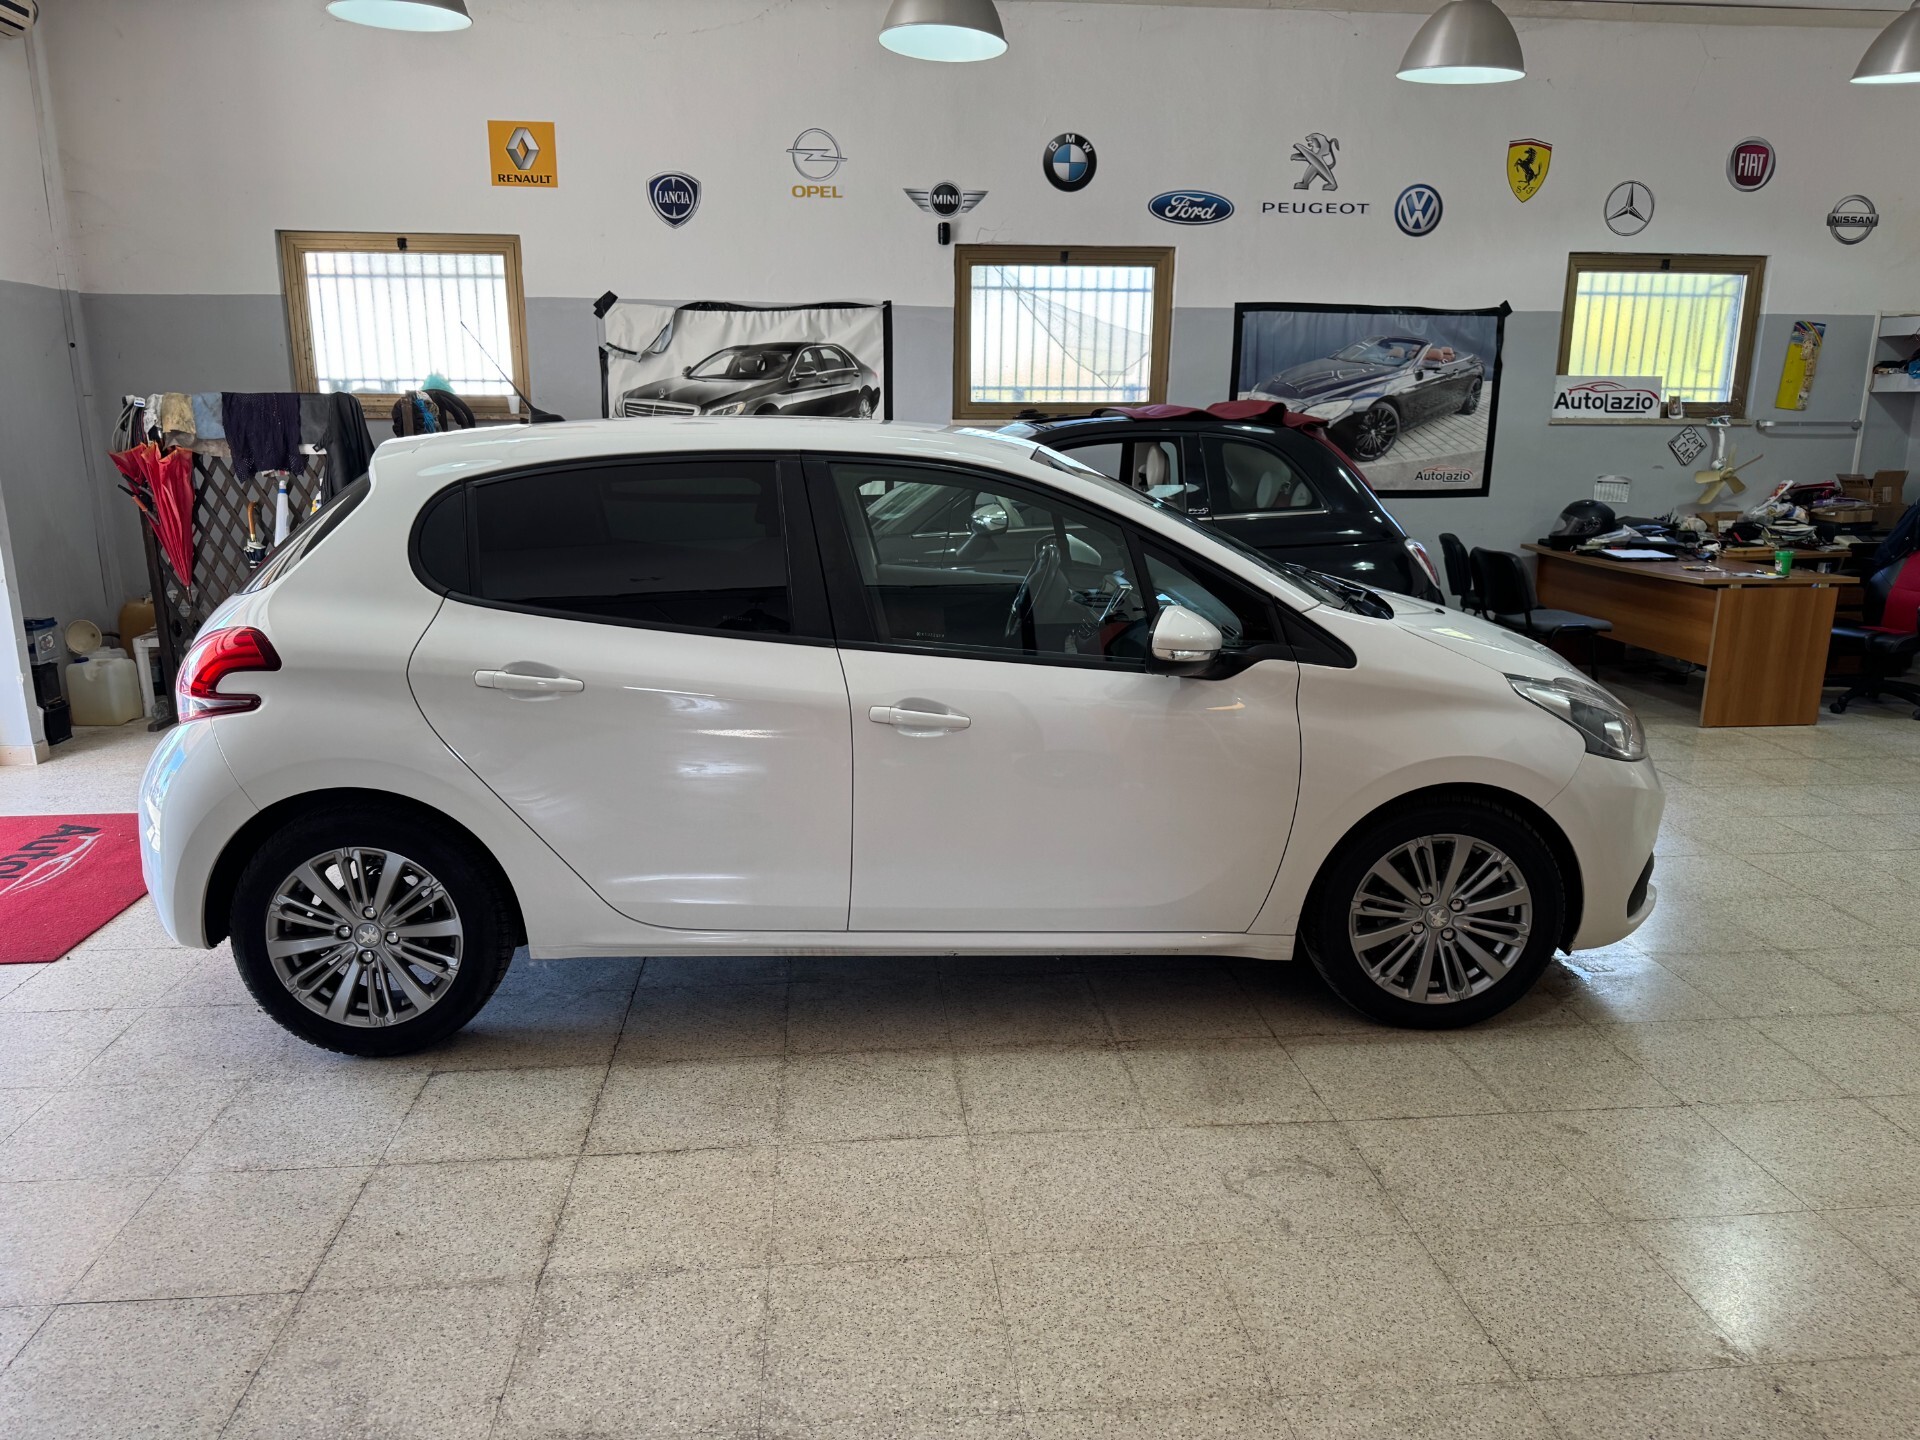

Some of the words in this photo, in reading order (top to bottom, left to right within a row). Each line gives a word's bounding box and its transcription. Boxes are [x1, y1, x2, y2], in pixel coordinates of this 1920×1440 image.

[1049, 134, 1092, 153] BMW
[1737, 153, 1766, 177] FIAT
[498, 174, 552, 184] RENAULT
[659, 190, 690, 204] LANCIA
[791, 185, 843, 198] OPEL
[933, 194, 959, 205] MINI
[1165, 195, 1217, 219] Ford
[1262, 202, 1370, 214] PEUGEOT
[1832, 215, 1874, 224] NISSAN
